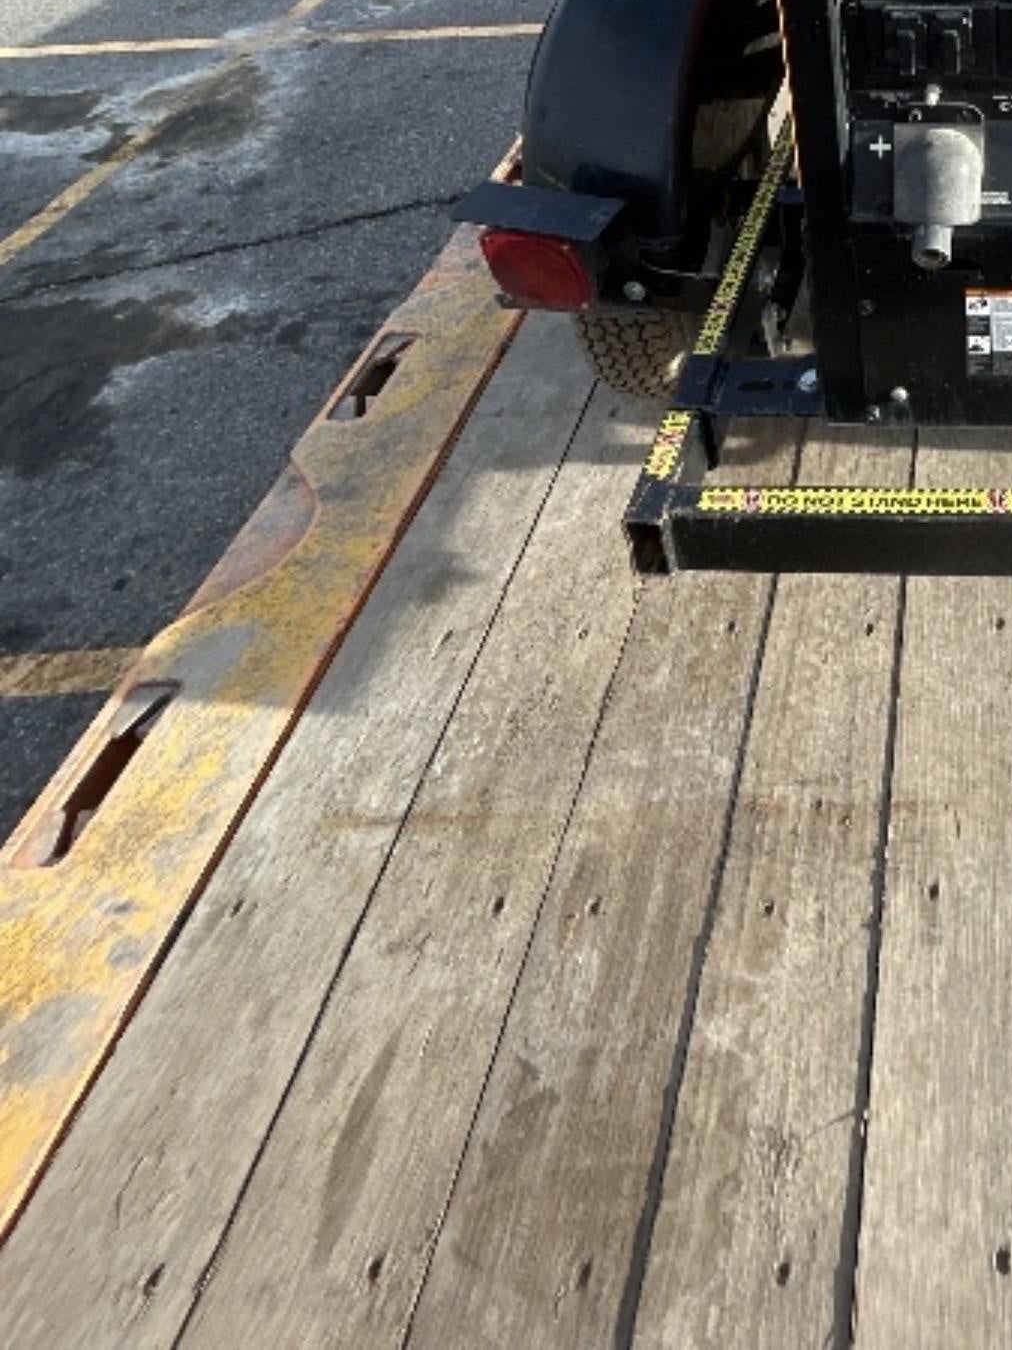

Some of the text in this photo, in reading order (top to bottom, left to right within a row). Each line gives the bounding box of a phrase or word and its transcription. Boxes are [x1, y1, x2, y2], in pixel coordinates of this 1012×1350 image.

[766, 495, 983, 509] DO NOT STAND HERE
